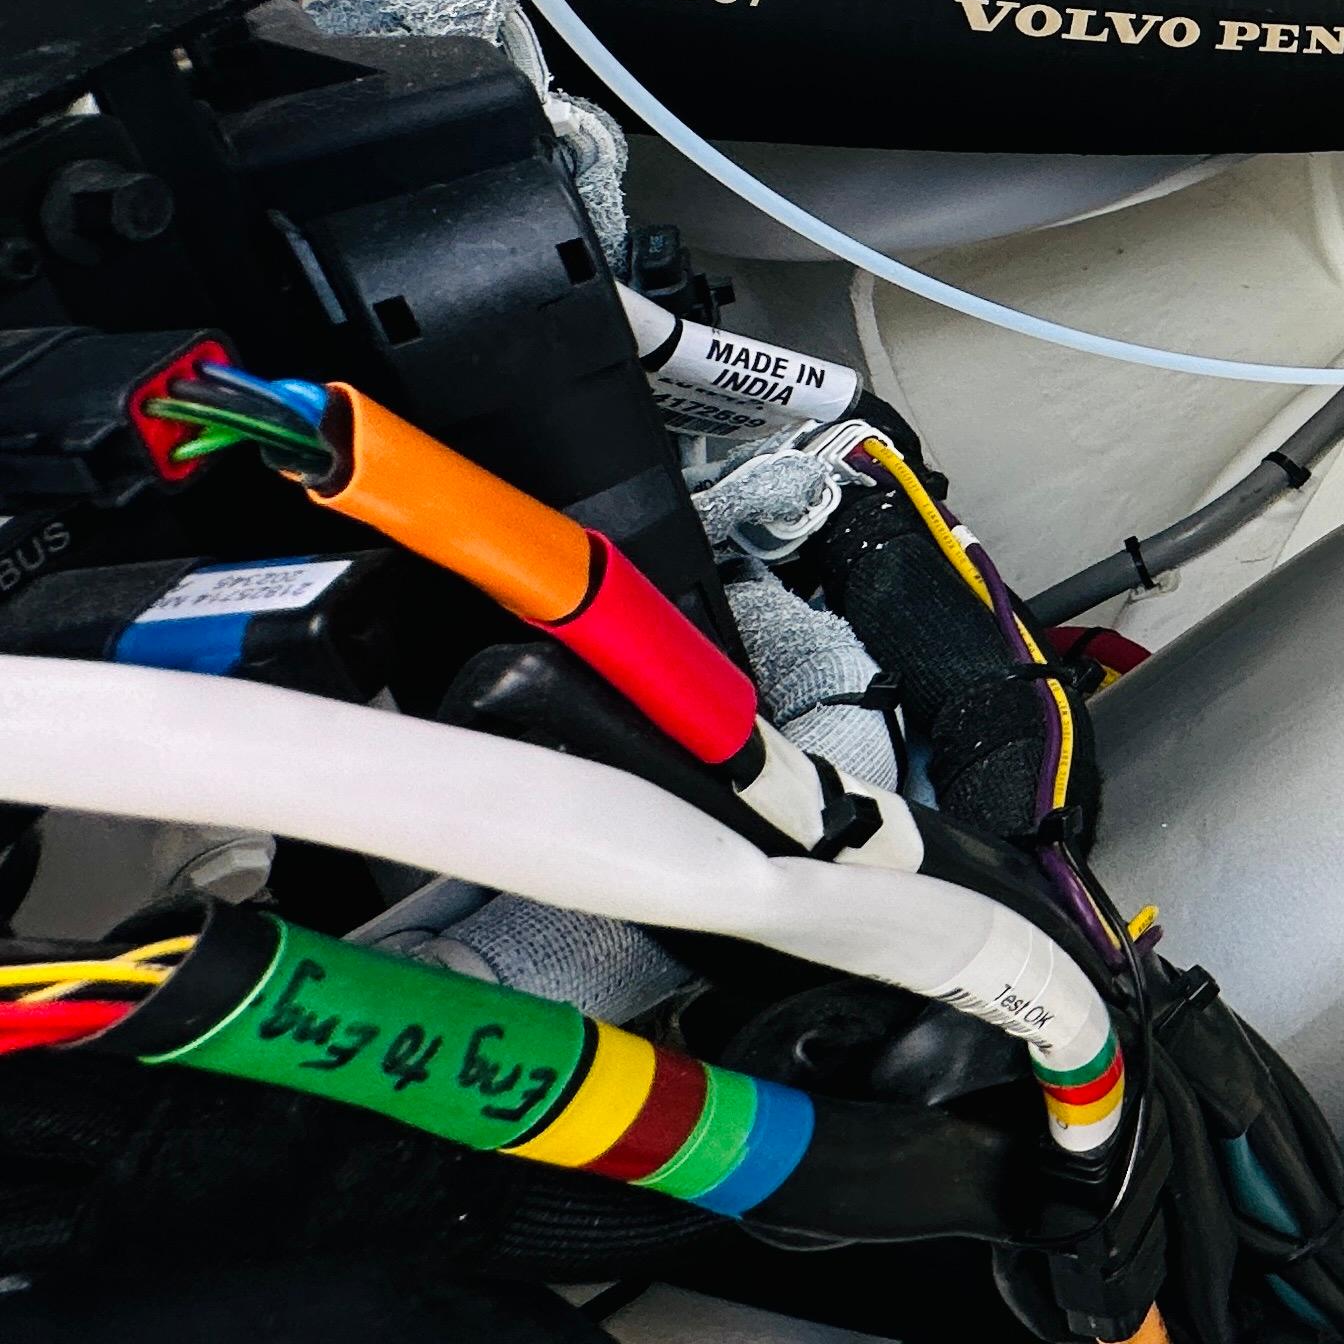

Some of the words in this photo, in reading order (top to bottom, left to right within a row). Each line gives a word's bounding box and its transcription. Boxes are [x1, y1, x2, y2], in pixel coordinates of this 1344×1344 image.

[705, 338, 790, 379] MADE
[796, 363, 826, 389] IN
[712, 368, 795, 406] INDIA
[258, 957, 382, 1072] Eng
[993, 983, 1031, 1017] Test
[1024, 1005, 1056, 1031] OK
[457, 1023, 558, 1123] Eng
